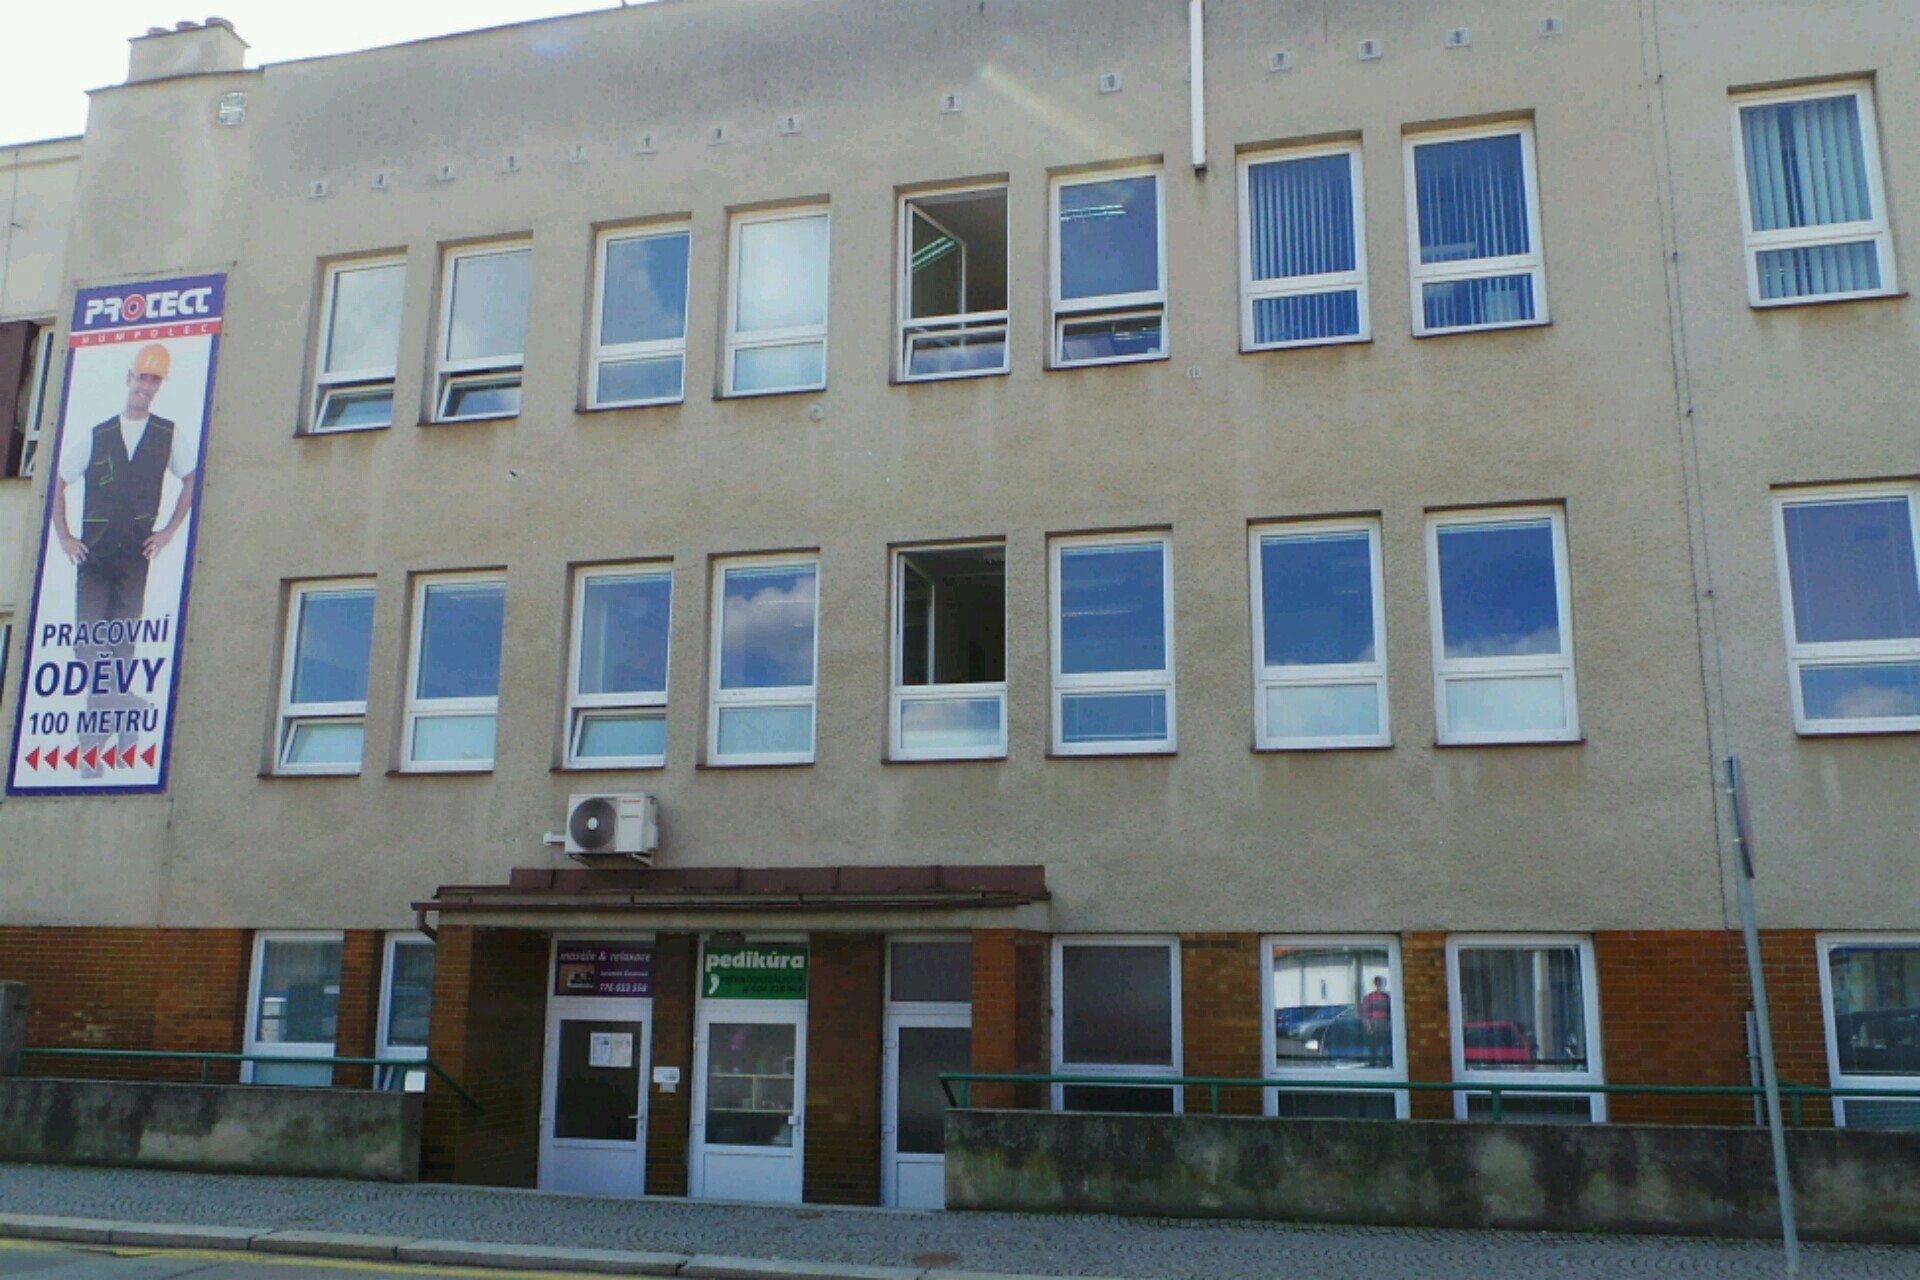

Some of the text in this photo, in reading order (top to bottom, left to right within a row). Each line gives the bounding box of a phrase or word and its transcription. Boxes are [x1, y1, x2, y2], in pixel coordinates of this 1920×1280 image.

[84, 286, 212, 325] PROTECT
[81, 323, 208, 344] HUMPOLEC
[41, 614, 171, 647] PRACOVNÍ
[34, 652, 166, 698] ODĚVY
[29, 703, 159, 736] 100 METRŮ
[598, 951, 607, 961] &
[704, 951, 805, 972] pedikúra
